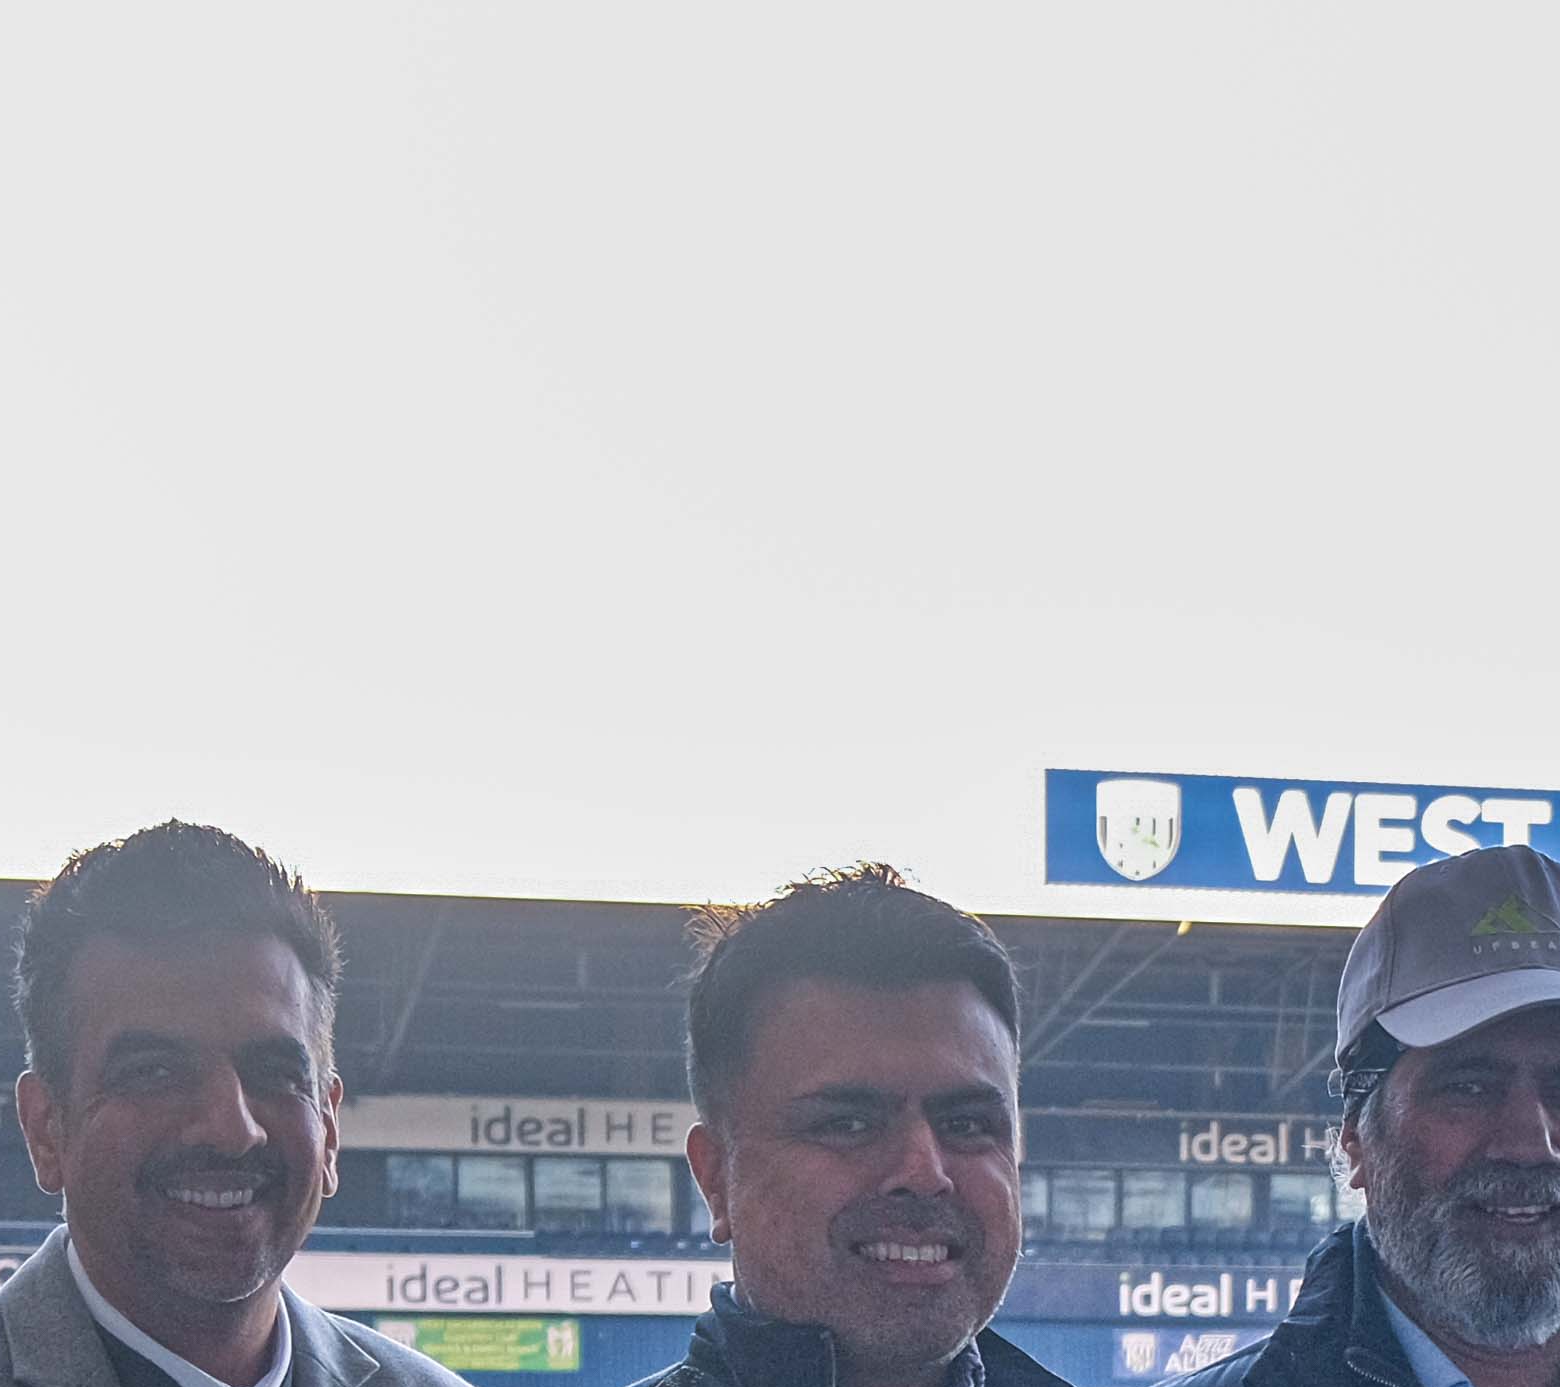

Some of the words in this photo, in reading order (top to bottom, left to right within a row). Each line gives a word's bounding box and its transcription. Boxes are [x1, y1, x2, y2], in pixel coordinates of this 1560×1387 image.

[1232, 787, 1552, 885] WEST
[471, 1105, 586, 1147] ideal
[1179, 1120, 1290, 1164] ideal
[386, 1264, 502, 1305] ideal
[1119, 1272, 1232, 1317] ideal
